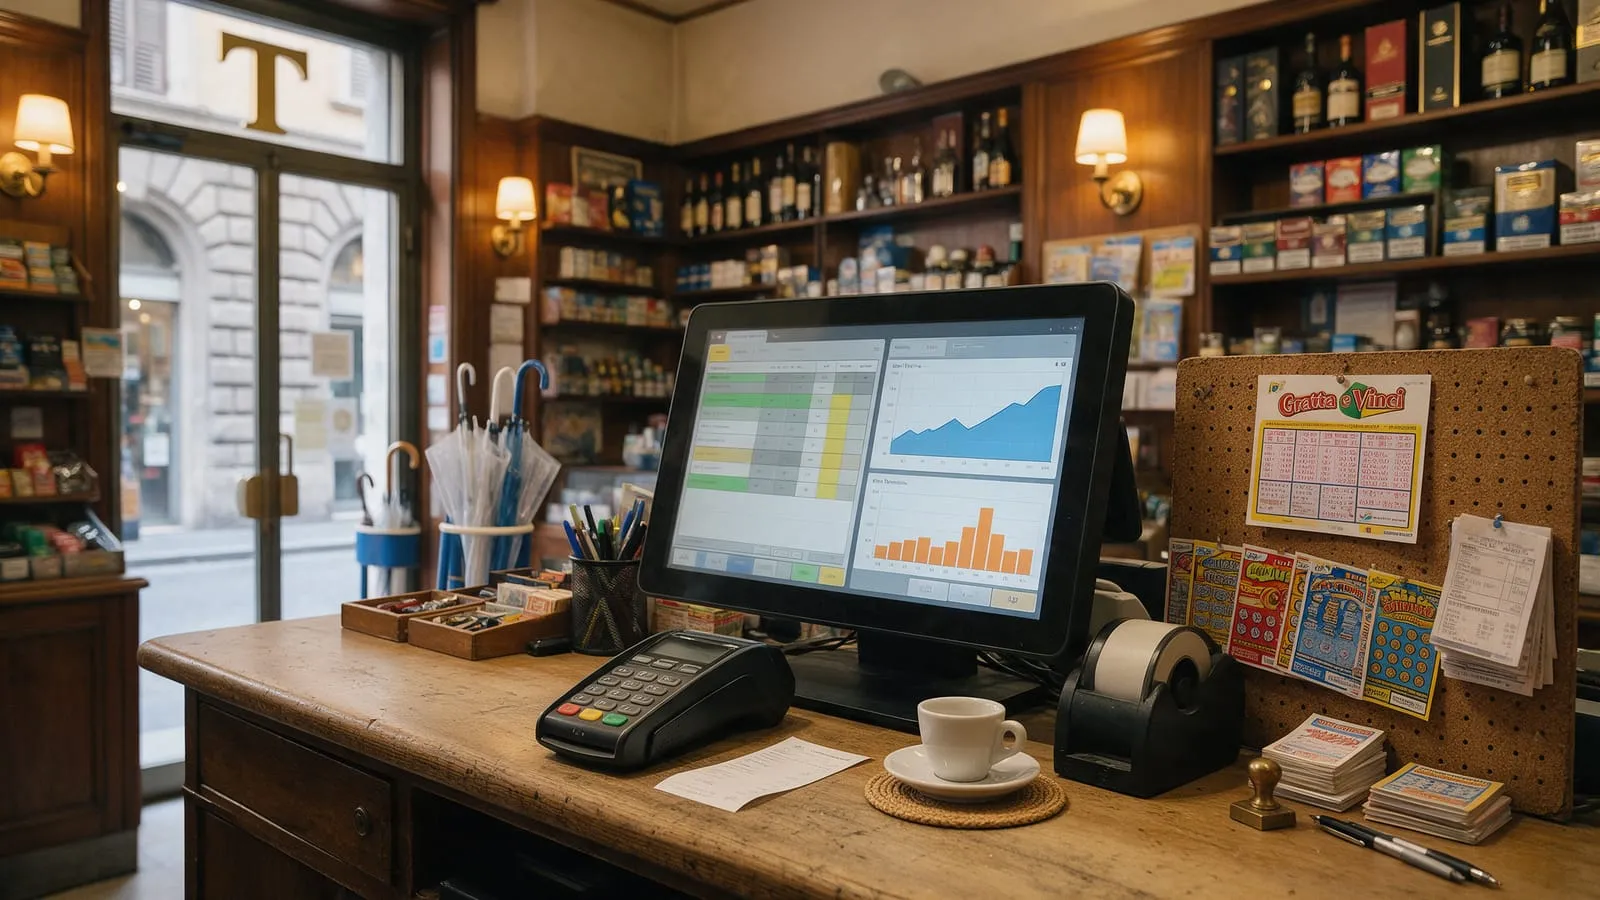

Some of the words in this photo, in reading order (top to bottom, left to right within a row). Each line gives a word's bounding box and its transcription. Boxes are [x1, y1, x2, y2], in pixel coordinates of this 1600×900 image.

[218, 31, 308, 135] T
[1278, 391, 1337, 417] Gratta
[1340, 395, 1351, 408] e
[1352, 387, 1406, 412] Vinci
